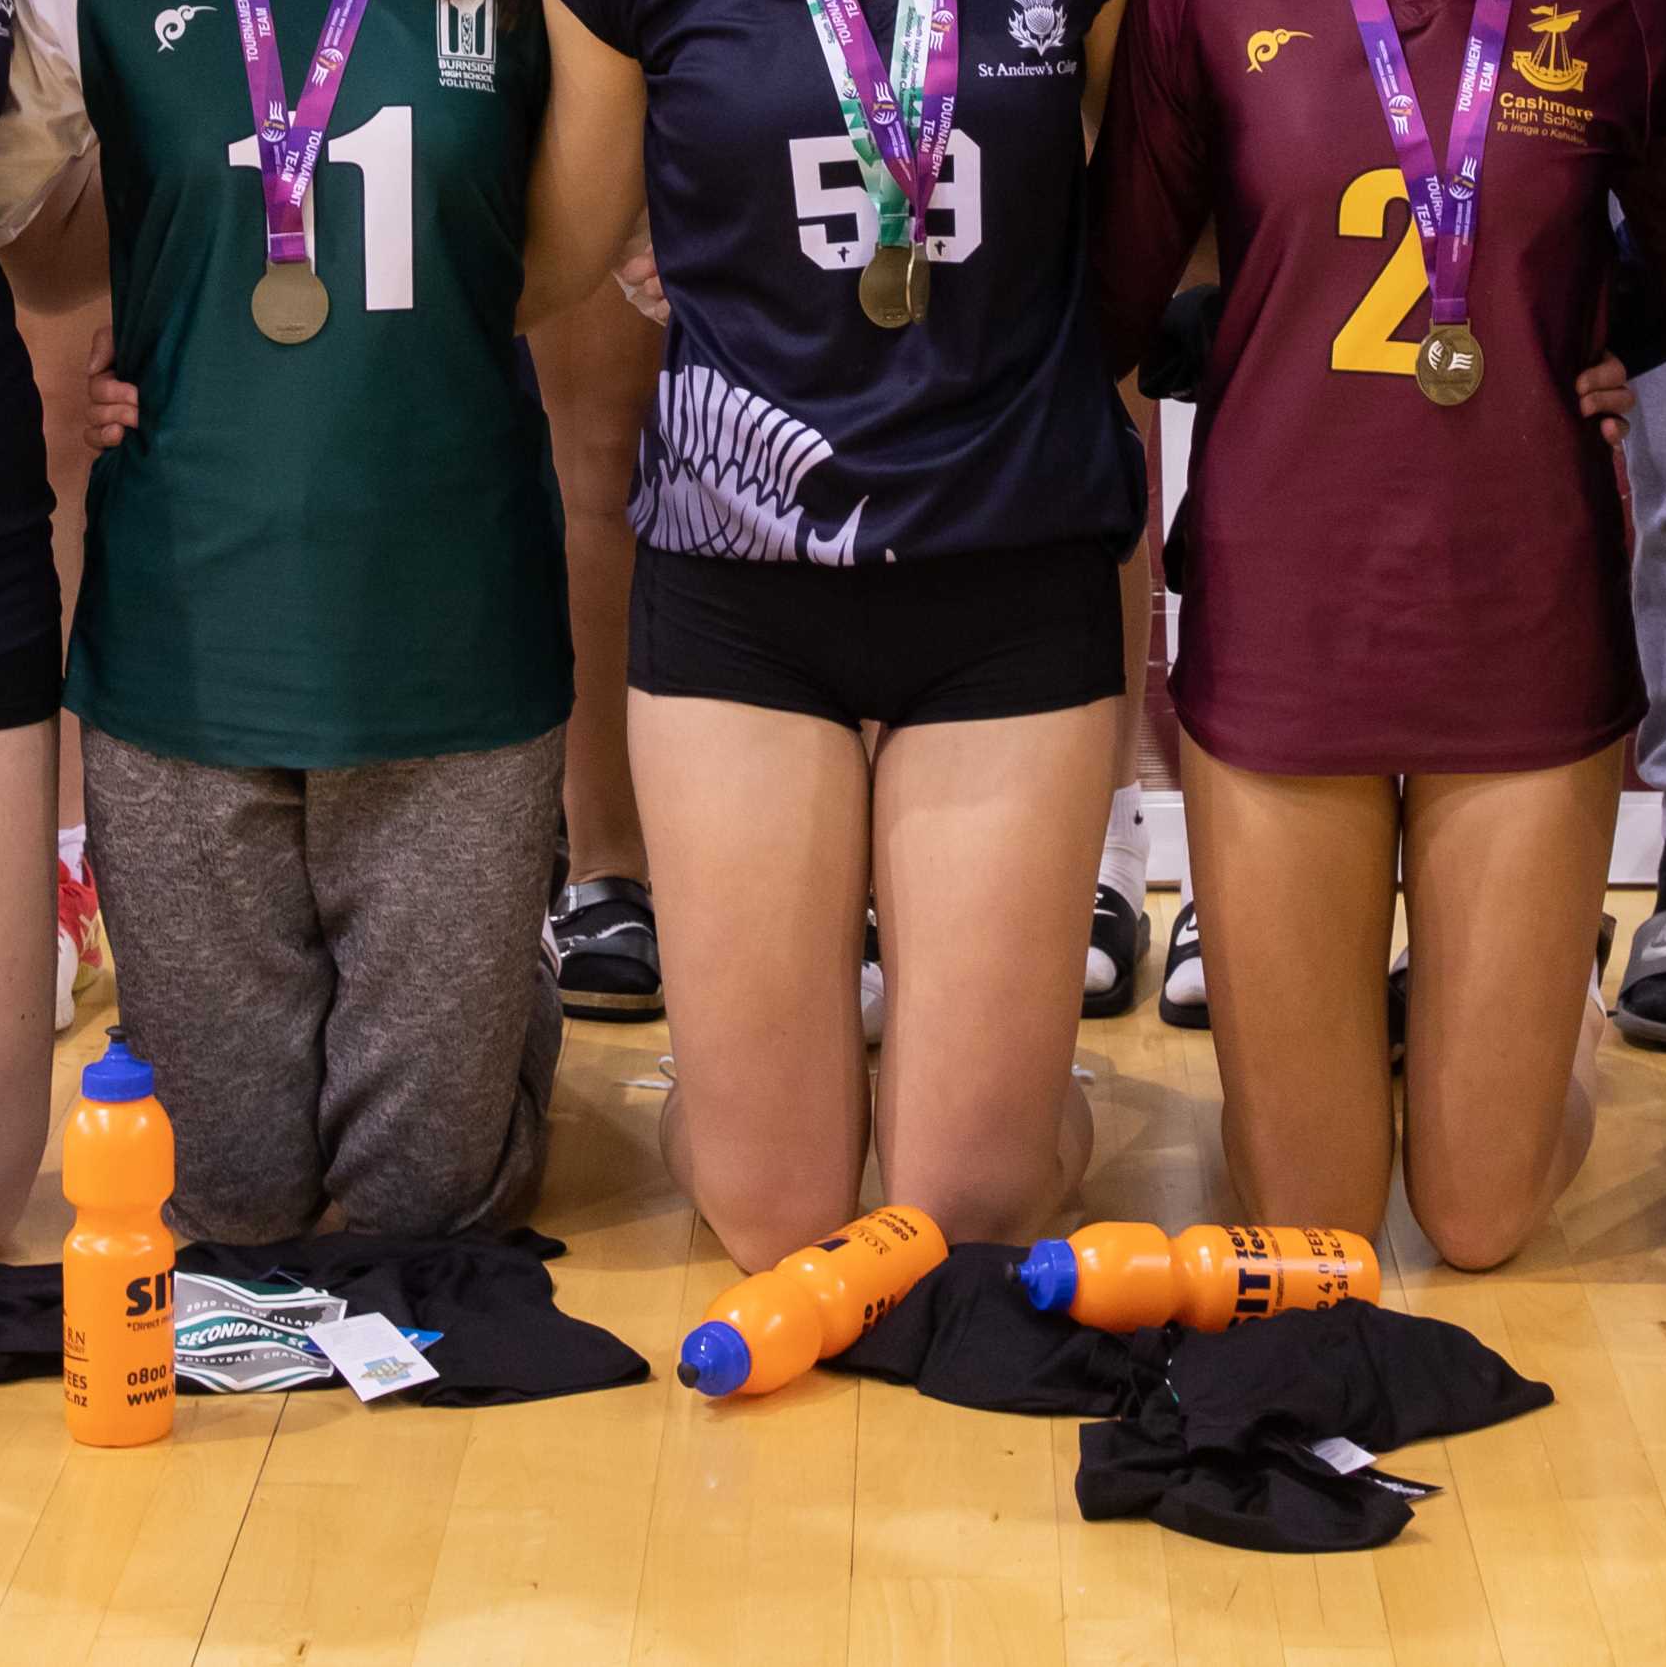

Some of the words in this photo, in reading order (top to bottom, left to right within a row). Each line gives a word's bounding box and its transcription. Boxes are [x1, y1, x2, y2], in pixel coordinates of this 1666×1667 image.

[255, 7, 271, 37] TEAM
[438, 59, 496, 75] BURNSIDE
[441, 70, 462, 79] HIGH
[463, 72, 493, 83] SCHOOL
[978, 63, 994, 77] St
[997, 61, 1054, 77] Andrew's
[1458, 36, 1483, 112] TOURNAMENT
[1478, 62, 1495, 94] TEAM
[439, 78, 496, 93] VOLLEYBALL
[1499, 92, 1593, 121] Cashmere
[1503, 108, 1538, 124] High
[1543, 112, 1587, 133] School
[921, 119, 936, 154] TEAM
[931, 95, 956, 178] TOURNAMENT
[280, 150, 299, 182] TEAM
[289, 130, 322, 208] TOURNAMENT
[1331, 168, 1430, 375] 2
[1229, 1267, 1271, 1327] IT
[177, 1321, 284, 1348] SECONDARY
[274, 1314, 319, 1328] ISLAN
[127, 1364, 167, 1387] 0800
[127, 1383, 175, 1407] www.
